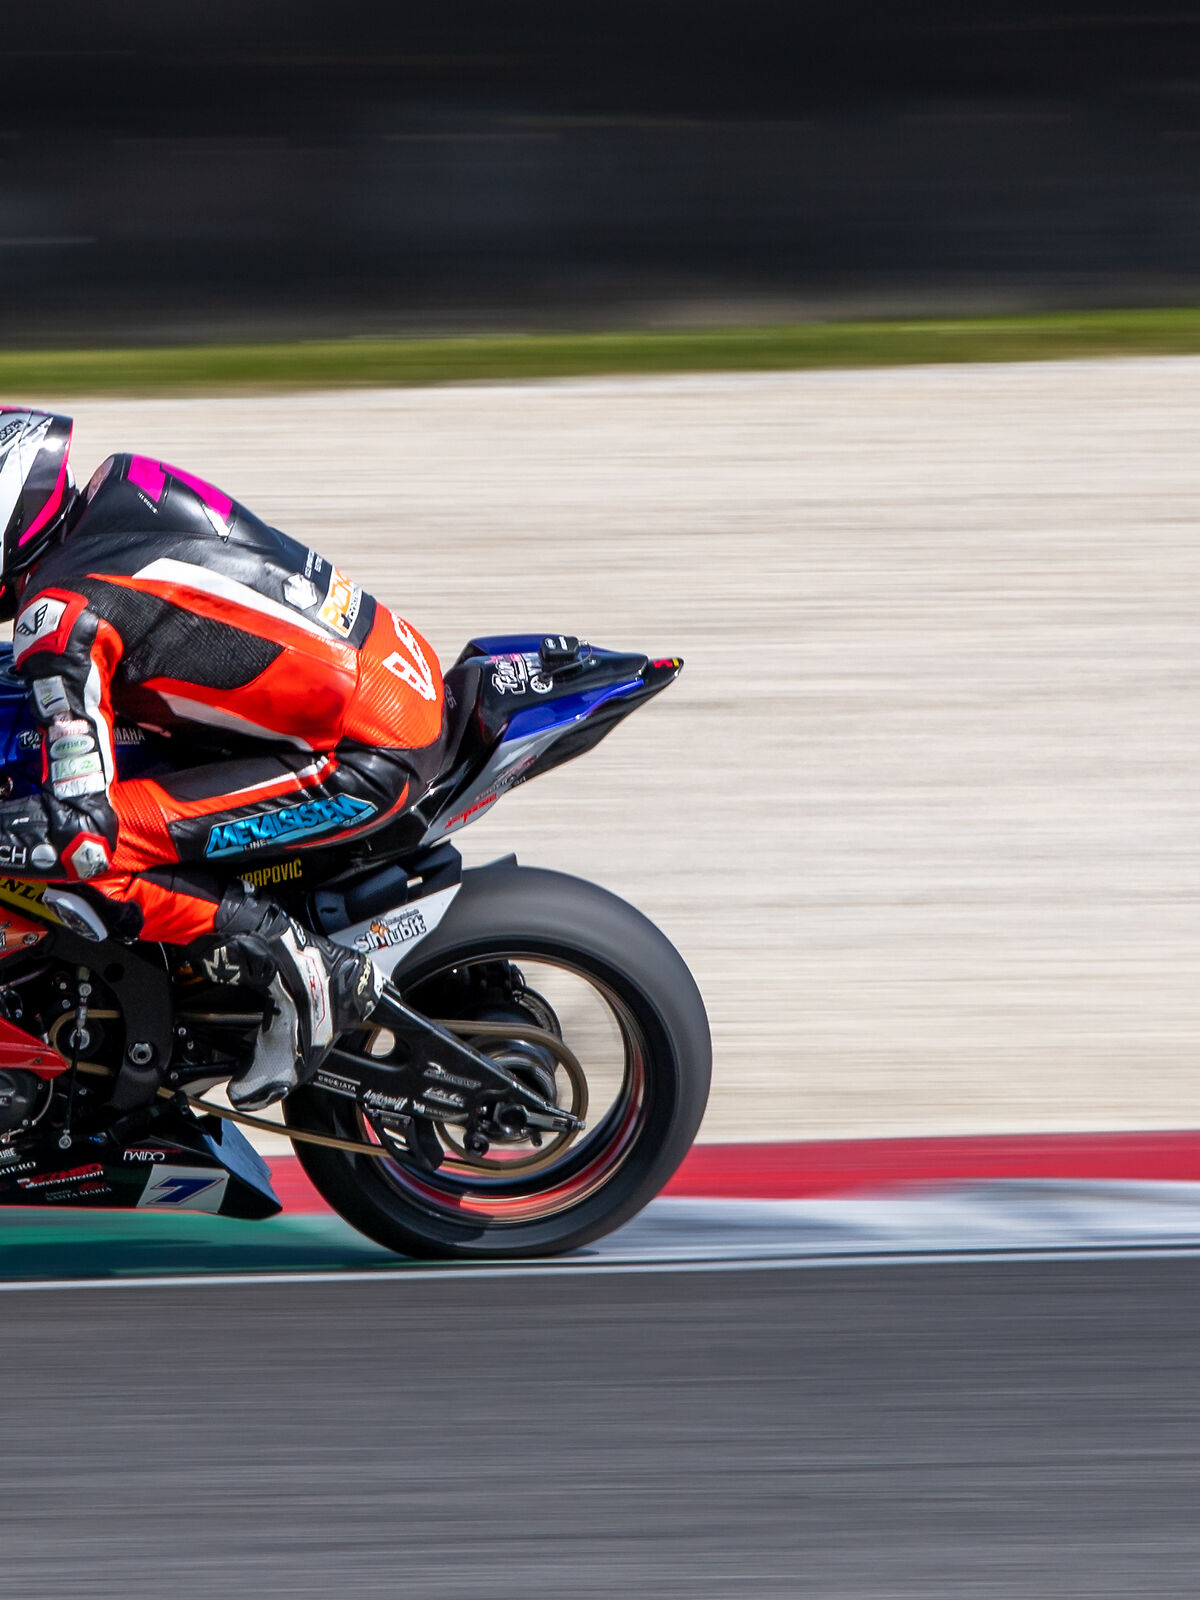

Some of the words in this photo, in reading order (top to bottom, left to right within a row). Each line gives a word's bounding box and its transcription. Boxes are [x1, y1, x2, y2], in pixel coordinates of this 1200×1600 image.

[113, 727, 146, 741] MAHA
[207, 794, 373, 855] METALSISTEM
[146, 1175, 225, 1206] 7
